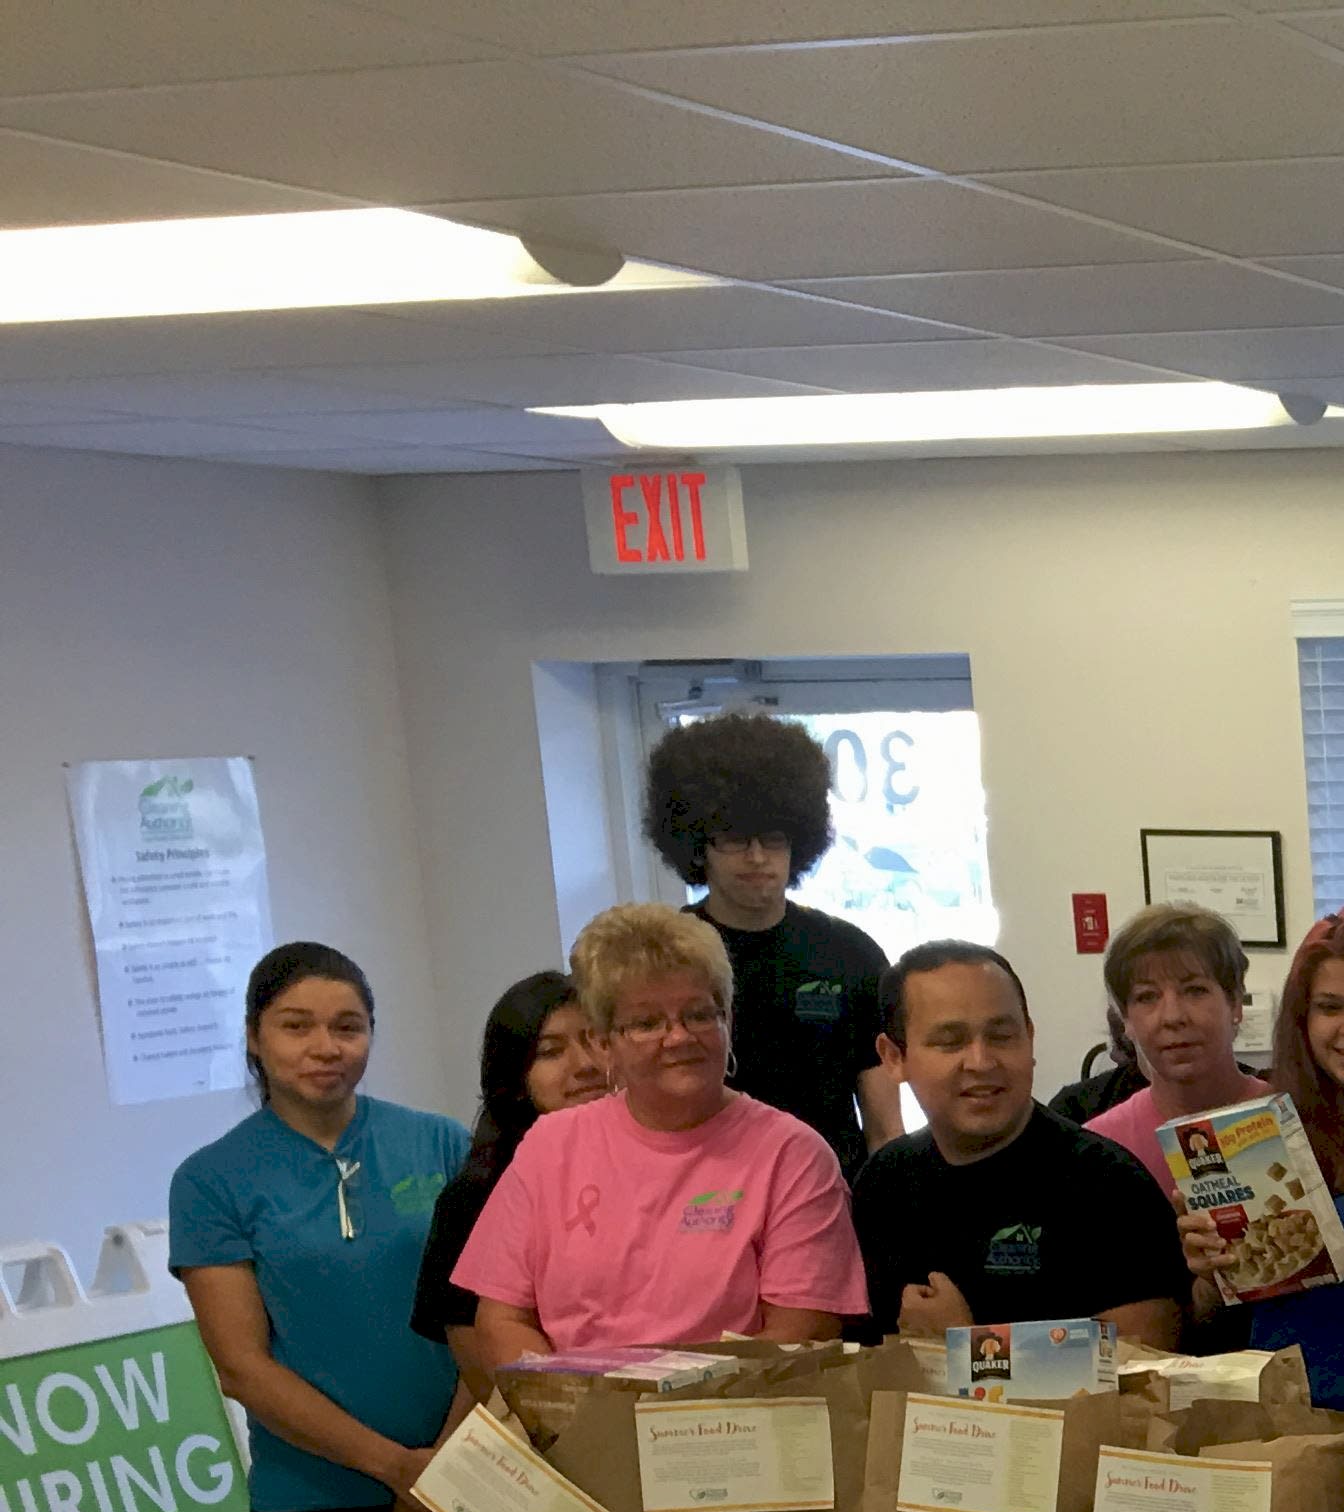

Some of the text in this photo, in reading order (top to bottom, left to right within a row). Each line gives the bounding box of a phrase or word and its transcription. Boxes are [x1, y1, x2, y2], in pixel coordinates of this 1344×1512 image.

[609, 472, 706, 563] EXIT
[1191, 1175, 1241, 1196] OATMEAL
[1187, 1185, 1256, 1211] SQUARES
[972, 1359, 1010, 1373] QUAKER
